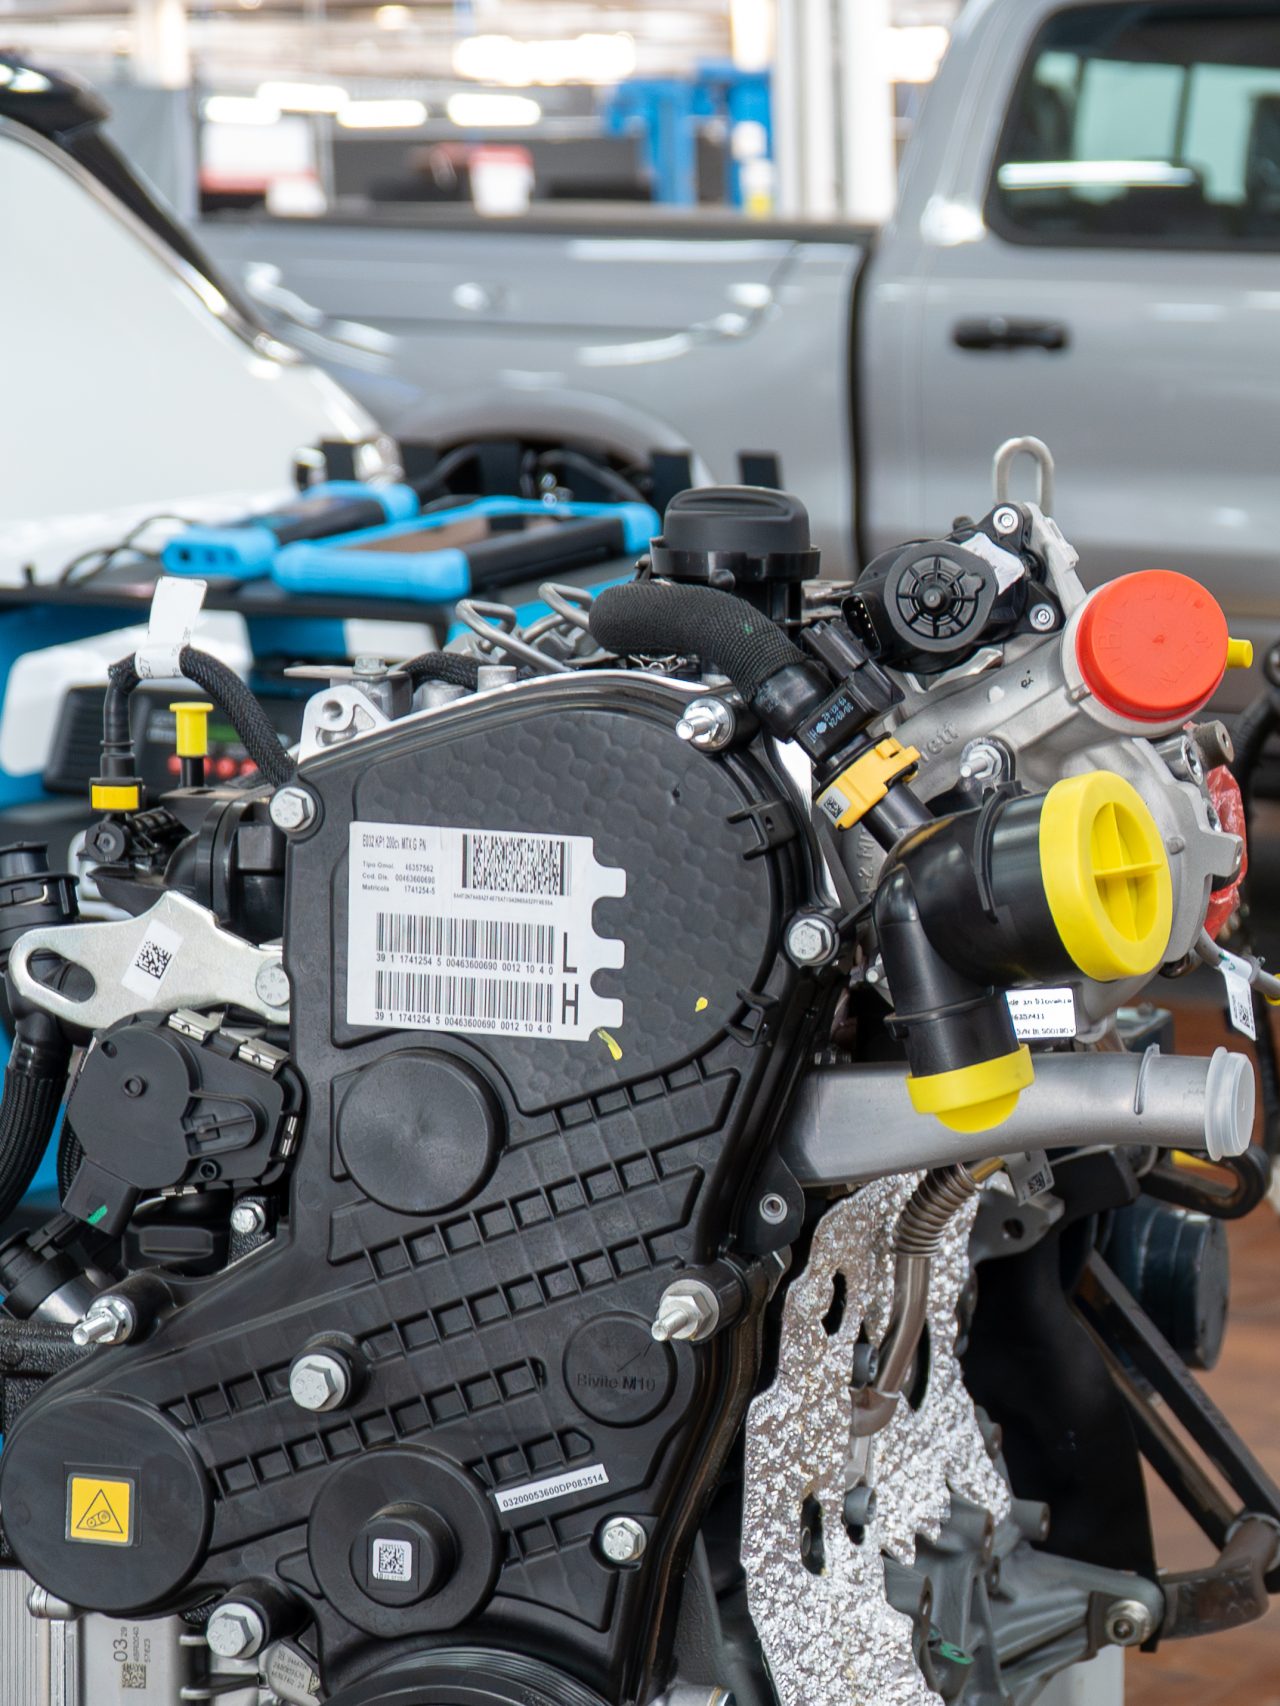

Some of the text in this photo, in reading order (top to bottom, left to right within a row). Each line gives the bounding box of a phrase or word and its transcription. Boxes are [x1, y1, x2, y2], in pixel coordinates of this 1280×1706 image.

[362, 883, 436, 896] Matricola 1741254-5
[376, 952, 386, 963] 39
[400, 954, 432, 966] 1741254
[436, 957, 442, 967] 5
[446, 958, 498, 972] 00463600690
[502, 961, 521, 973] 0012
[526, 964, 536, 974] 10
[539, 965, 545, 974] 4
[548, 966, 554, 976] 0
[562, 931, 578, 974] L
[561, 982, 580, 1026] H
[375, 1011, 385, 1021] 39
[398, 1013, 431, 1024] 1741254
[435, 1016, 441, 1025] 5
[444, 1017, 496, 1030] 00463600690
[500, 1020, 520, 1032] 0012
[524, 1023, 534, 1033] 10
[537, 1024, 543, 1033] 4
[547, 1025, 553, 1034] 0
[113, 1639, 128, 1662] 03
